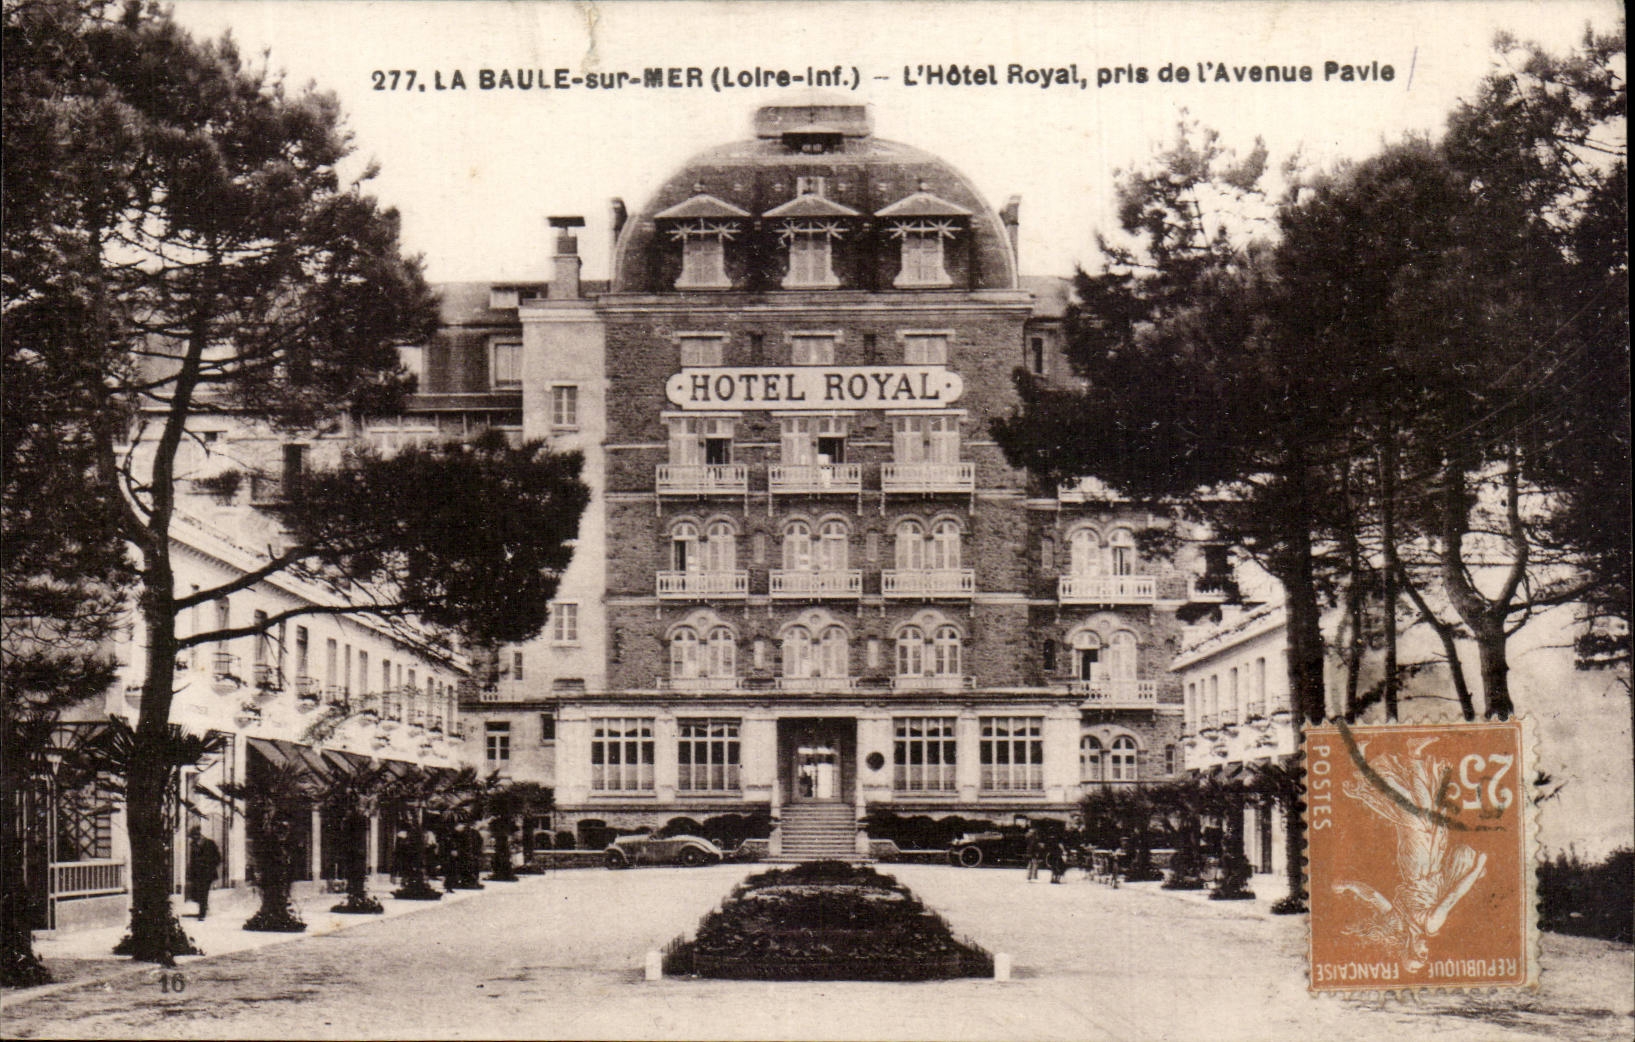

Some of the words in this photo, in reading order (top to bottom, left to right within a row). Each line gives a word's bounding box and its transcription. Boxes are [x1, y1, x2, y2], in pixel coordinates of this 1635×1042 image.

[690, 373, 806, 402] HOTEL
[824, 373, 940, 401] ROYAL
[1312, 745, 1332, 831] POSTES
[1315, 962, 1399, 981] FRANÇAISE
